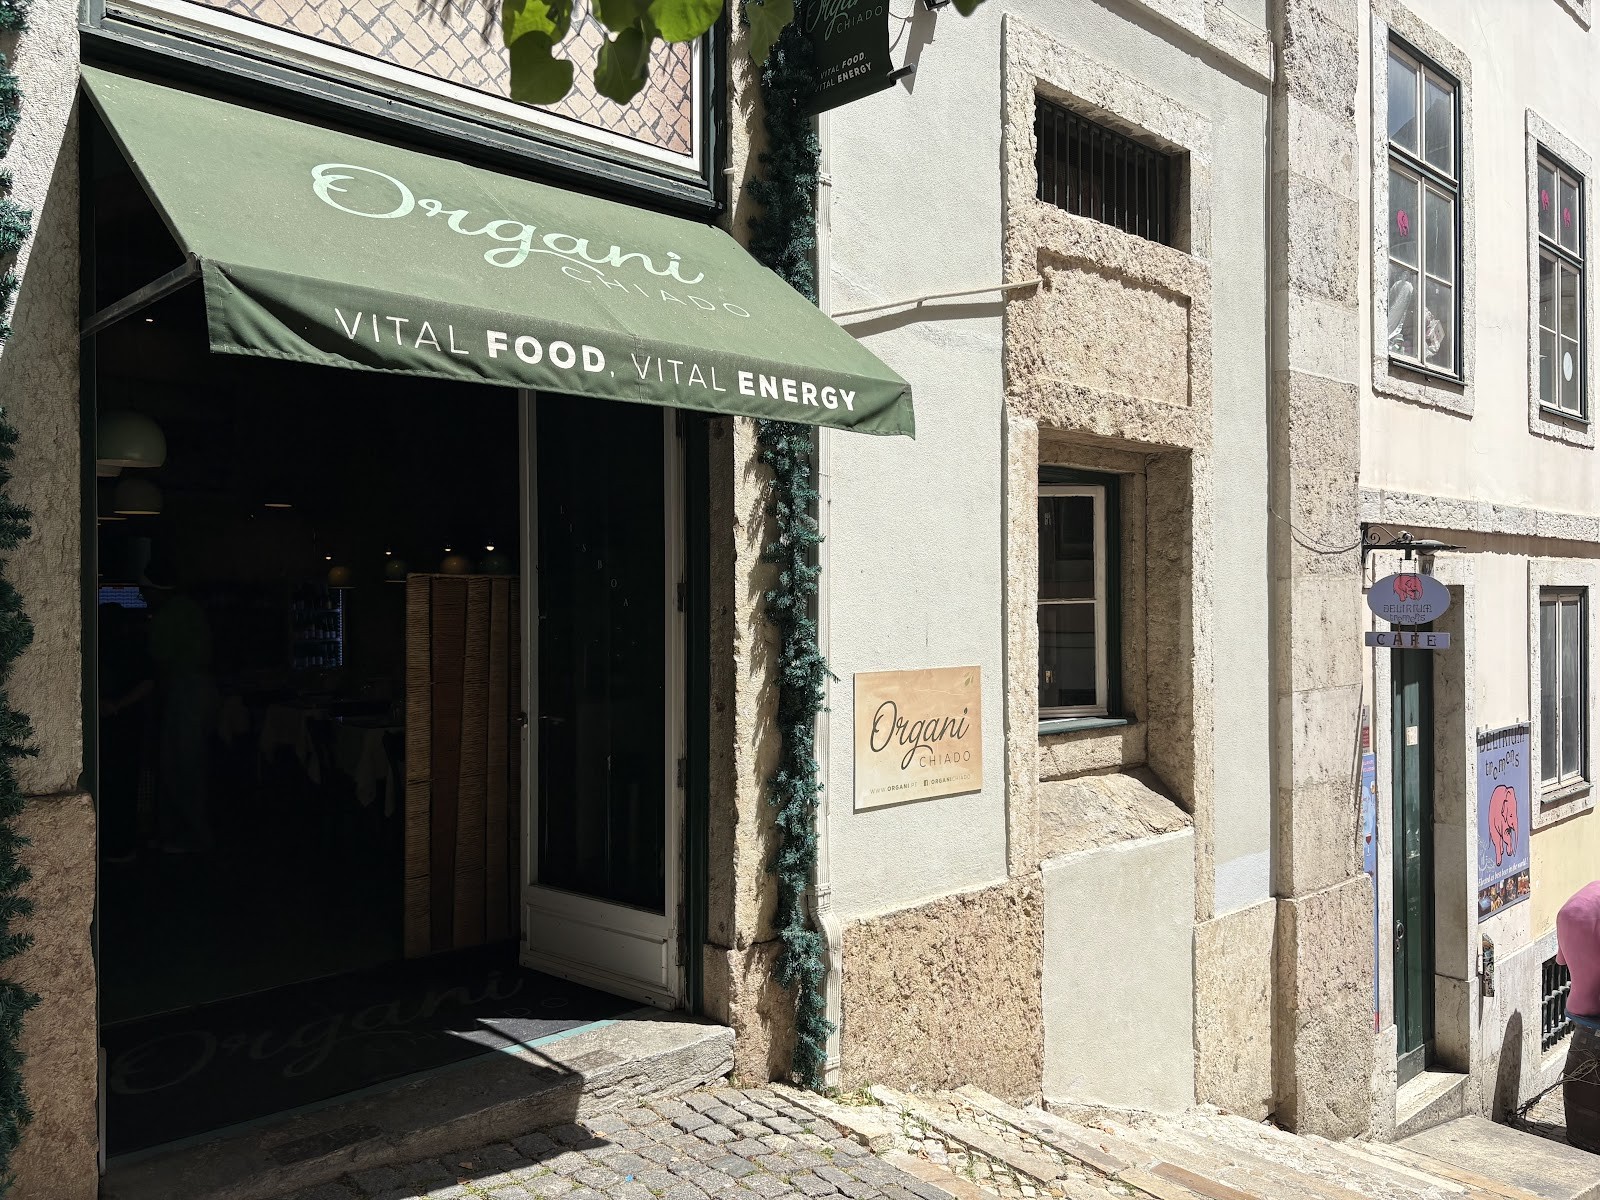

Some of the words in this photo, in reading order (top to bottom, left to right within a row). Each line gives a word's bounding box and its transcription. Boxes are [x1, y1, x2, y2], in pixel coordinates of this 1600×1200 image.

[836, 6, 883, 34] CHIADO
[820, 64, 840, 79] VITAL
[837, 62, 872, 83] ENERGY
[311, 163, 704, 284] Organi
[561, 266, 750, 318] CHIADO
[334, 307, 469, 355] VITAL
[486, 330, 616, 378] FOOD,
[630, 352, 727, 392] VITAL
[737, 370, 857, 411] ENERGY
[1383, 604, 1433, 613] DELIRIUM
[1376, 633, 1437, 648] CAFE
[870, 700, 970, 770] Organi
[1479, 725, 1525, 753] DELIRIUM
[919, 750, 971, 768] CHIADO
[1485, 749, 1520, 780] tremens
[110, 968, 526, 1095] Organi
